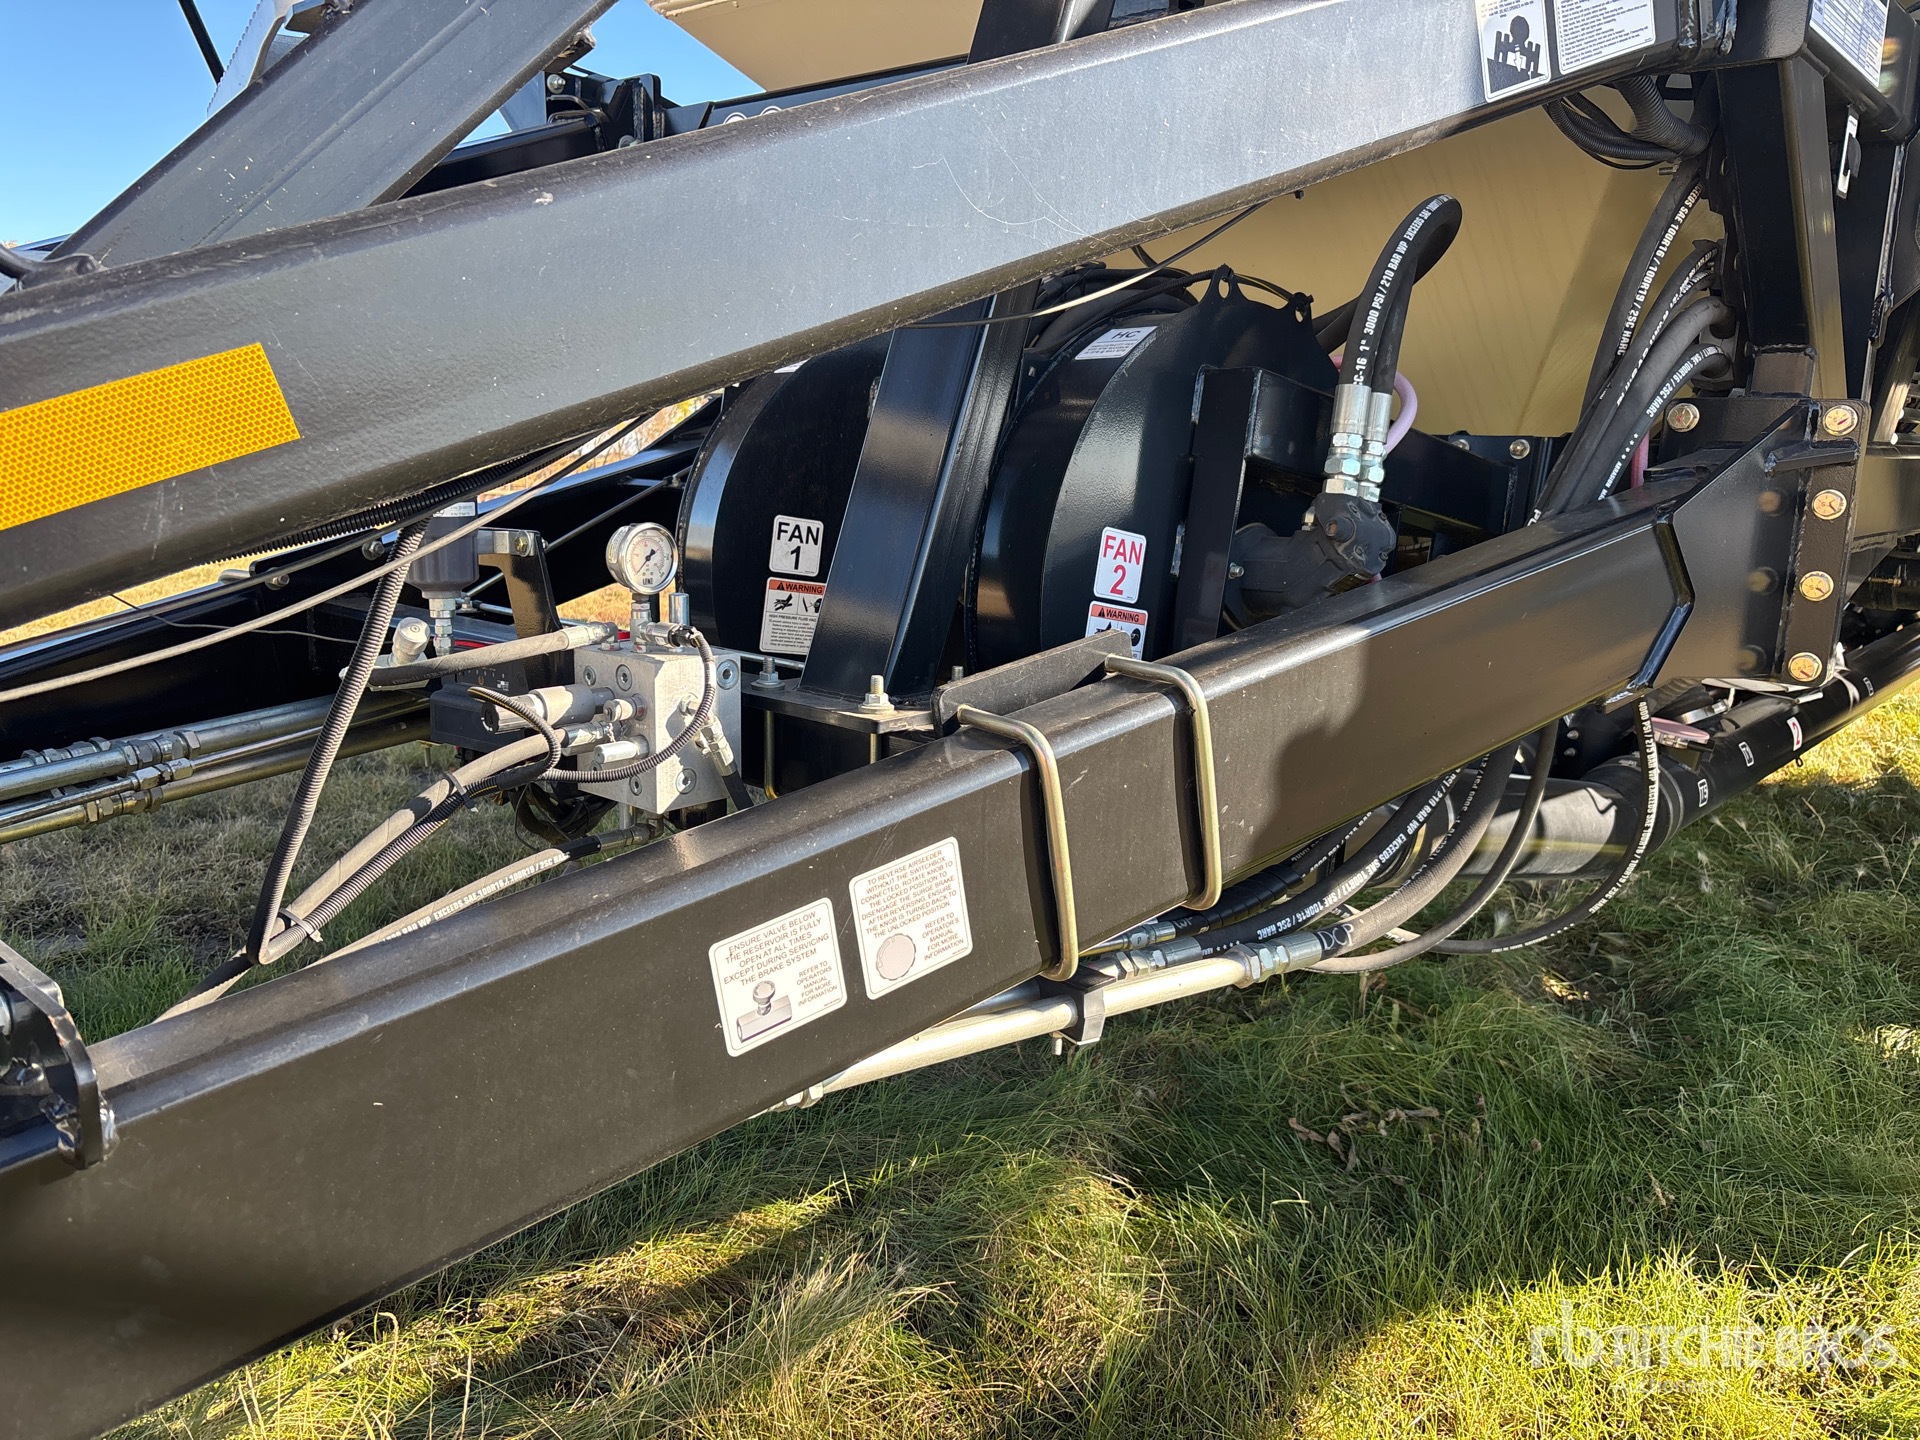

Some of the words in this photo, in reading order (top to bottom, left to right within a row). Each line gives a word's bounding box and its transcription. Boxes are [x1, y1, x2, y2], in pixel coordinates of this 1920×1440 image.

[1419, 208, 1432, 220] SAE
[1674, 207, 1689, 223] SAE
[1403, 216, 1425, 241] EXCEEDS
[1395, 241, 1409, 254] WP
[1656, 224, 1679, 258] 100R16
[1388, 252, 1403, 273] BAR
[1380, 270, 1395, 289] 210
[1635, 265, 1658, 302] 100R19
[1371, 292, 1385, 310] PSI
[1364, 310, 1380, 335] 3000
[1625, 310, 1639, 328] 2SC
[1111, 330, 1141, 340] HC
[1616, 330, 1632, 356] HARC
[1691, 353, 1702, 365] SAE
[1673, 361, 1694, 383] 100R16
[1660, 383, 1673, 399] 2SC
[1646, 395, 1663, 418] HARC
[777, 521, 820, 546] FAN
[790, 545, 801, 570] 1
[1103, 534, 1143, 565] FAN
[785, 583, 823, 594] WARNING
[1110, 564, 1127, 596] 2
[1106, 608, 1139, 623] WARNING
[1642, 720, 1652, 734] PSI
[1428, 790, 1443, 807] 210
[1416, 805, 1432, 821] BAR
[1407, 819, 1420, 835] WP
[1379, 833, 1407, 863] EXCEEDS
[866, 877, 895, 895] WITHOUT
[896, 873, 908, 882] THE
[909, 856, 946, 876] SWITCHBOX
[878, 865, 907, 881] REVERSE
[908, 850, 942, 869] AIRSEEDER
[902, 873, 925, 887] ROTATE
[927, 865, 944, 876] KNOB
[945, 860, 953, 868] TO
[1365, 858, 1381, 876] SAE
[433, 899, 464, 920] EXCEEDS
[540, 858, 553, 869] 2SC
[869, 900, 882, 909] THE
[883, 888, 909, 903] LOCKED
[909, 875, 938, 891] POSITION
[1342, 870, 1368, 896] 100R17
[861, 900, 897, 921] DISENGAGE
[899, 895, 910, 903] THE
[913, 885, 933, 898] SURGE
[935, 875, 955, 888] BRAKE
[868, 913, 889, 926] AFTER
[928, 884, 952, 899] ENSURE
[866, 926, 878, 934] THE
[880, 918, 897, 929] KNOB
[906, 902, 931, 917] TURNED
[931, 894, 947, 905] BACK
[949, 890, 957, 898] TO
[925, 916, 945, 929] REFER
[1296, 901, 1323, 923] 100R16
[728, 934, 761, 953] ENSURE
[763, 924, 787, 938] VALVE
[789, 911, 816, 928] BELOW
[874, 931, 886, 939] THE
[887, 914, 921, 933] UNLOCKED
[930, 929, 953, 942] MANUAL
[1257, 925, 1276, 940] HARC
[1277, 918, 1292, 932] 2SC
[725, 952, 741, 964] THE
[743, 933, 788, 957] RESERVOIR
[790, 928, 798, 937] IS
[799, 917, 821, 932] FULLY
[927, 942, 940, 951] FOR
[941, 933, 958, 944] MORE
[1317, 923, 1355, 950] DCP
[724, 965, 755, 984] EXCEPT
[757, 952, 787, 970] DURING
[789, 933, 829, 956] SERVICING
[739, 952, 761, 967] OPEN
[763, 947, 773, 957] AT
[774, 943, 787, 953] ALL
[789, 931, 812, 946] TIMES
[924, 938, 964, 961] INFORMATION
[741, 974, 755, 986] THE
[758, 963, 784, 979] BRAKE
[786, 948, 817, 967] SYSTEM
[798, 965, 818, 977] REFER
[820, 960, 828, 968] TO
[801, 989, 814, 998] FOR
[815, 980, 832, 993] MORE
[804, 976, 827, 989] MANUAL
[798, 985, 838, 1006] INFORMATION
